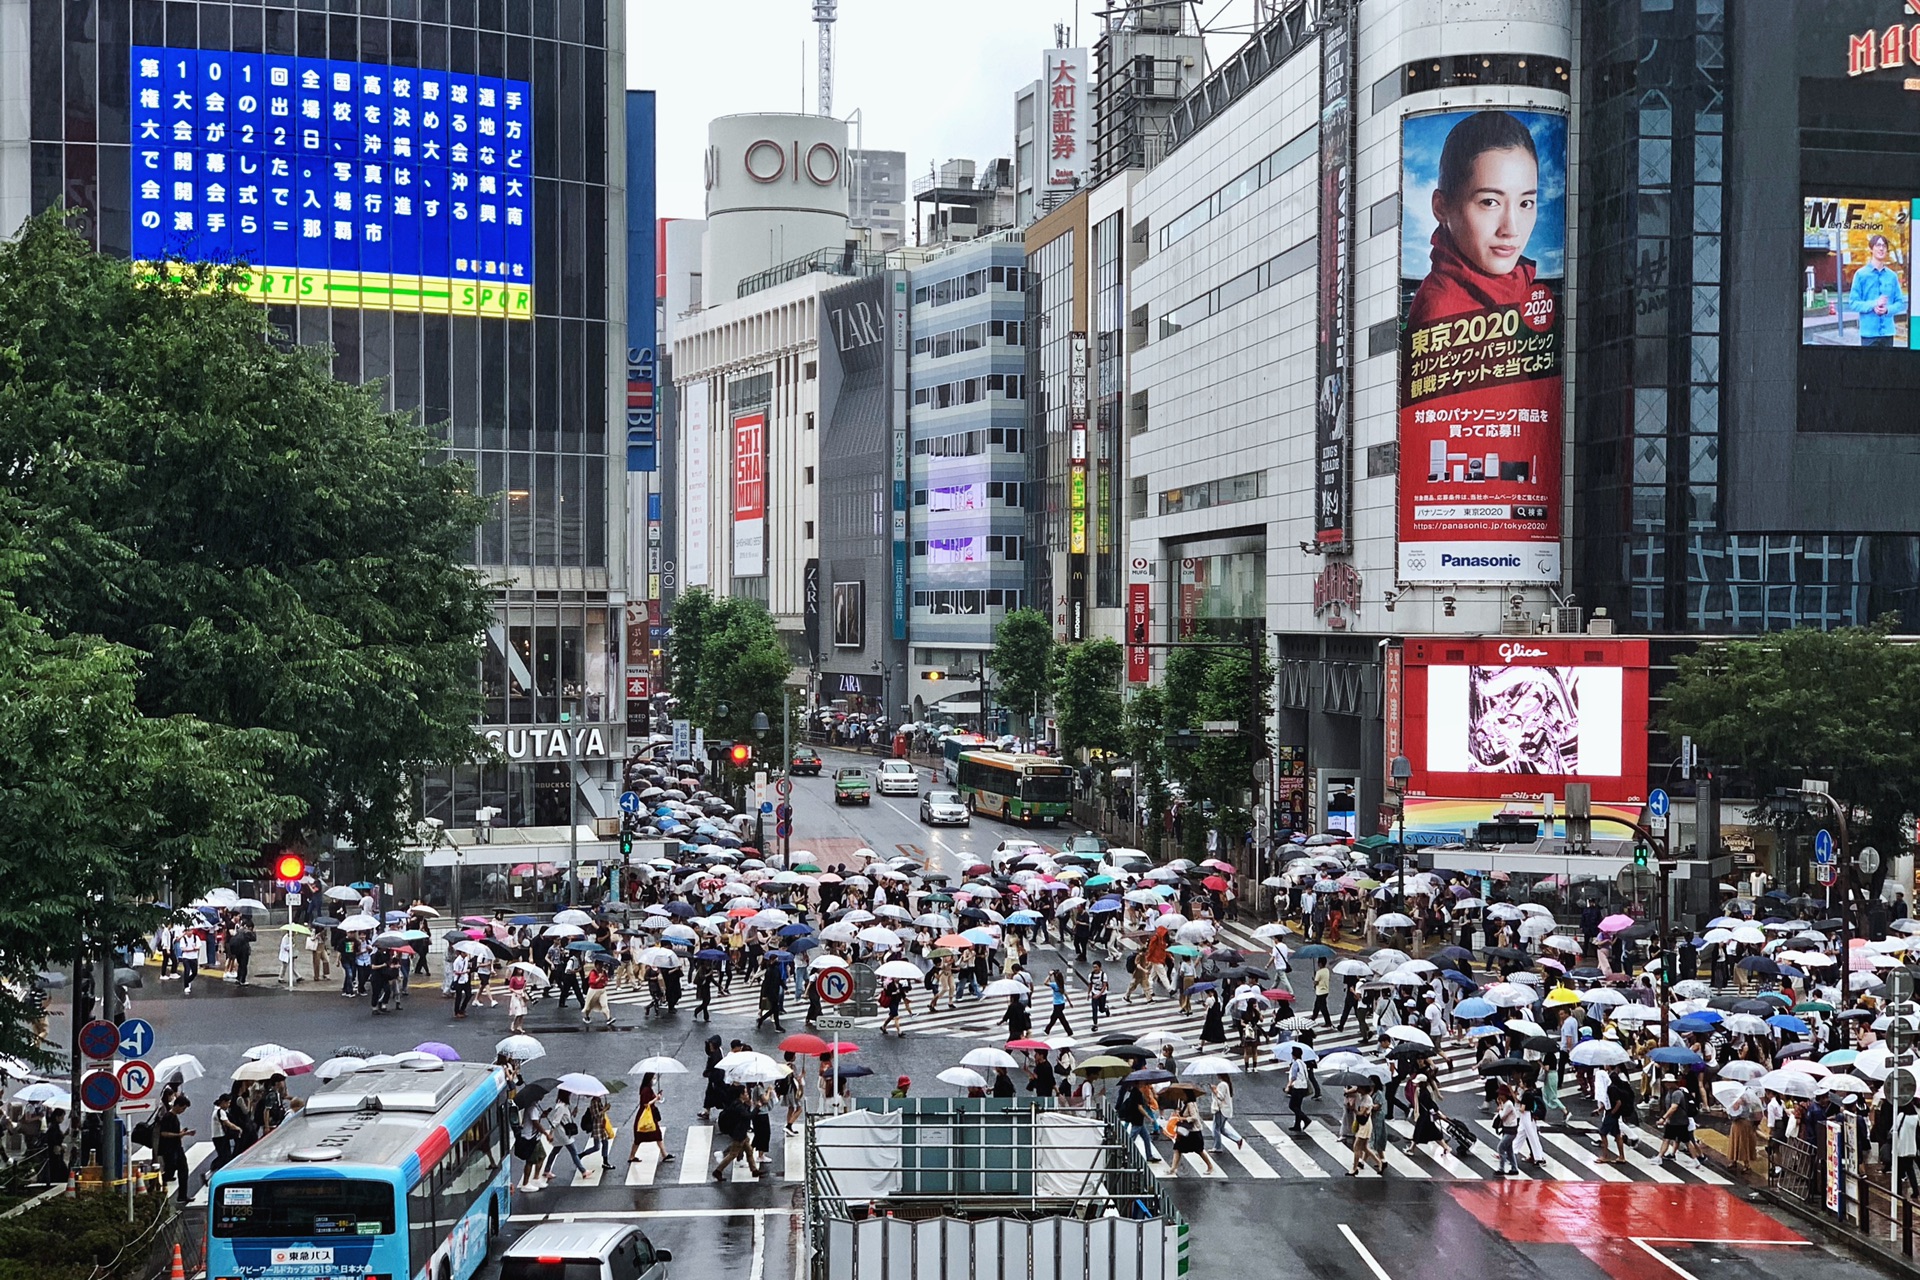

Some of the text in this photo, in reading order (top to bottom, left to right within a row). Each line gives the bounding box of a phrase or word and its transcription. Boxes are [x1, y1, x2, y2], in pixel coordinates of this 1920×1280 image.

[139, 87, 522, 139] 権大会の出場校を決める地方
[1052, 60, 1076, 160] 大和証券
[140, 150, 523, 198] で開幕した。写真は、沖縄大
[140, 180, 523, 226] 会開会式で入場行進する興南
[1524, 298, 1553, 317] 2020
[832, 298, 884, 351] ZARA
[1411, 310, 1519, 358] 東京2020
[1411, 352, 1554, 399] 観戦チケットを当てよう!
[628, 347, 653, 448] SEIBU
[1414, 408, 1548, 424] 対象のパナソニック商品を
[1417, 507, 1503, 517] パナソニック 東京2020
[1413, 522, 1548, 531] https://panasonic.jp/tokyo2020/
[1441, 554, 1521, 567] Panasonic
[806, 568, 817, 614] ZARA
[1499, 643, 1547, 663] Glico
[630, 680, 645, 695] 本
[839, 676, 861, 692] ZARA
[818, 1019, 852, 1028] ここから
[289, 1251, 331, 1261] 東急バス
